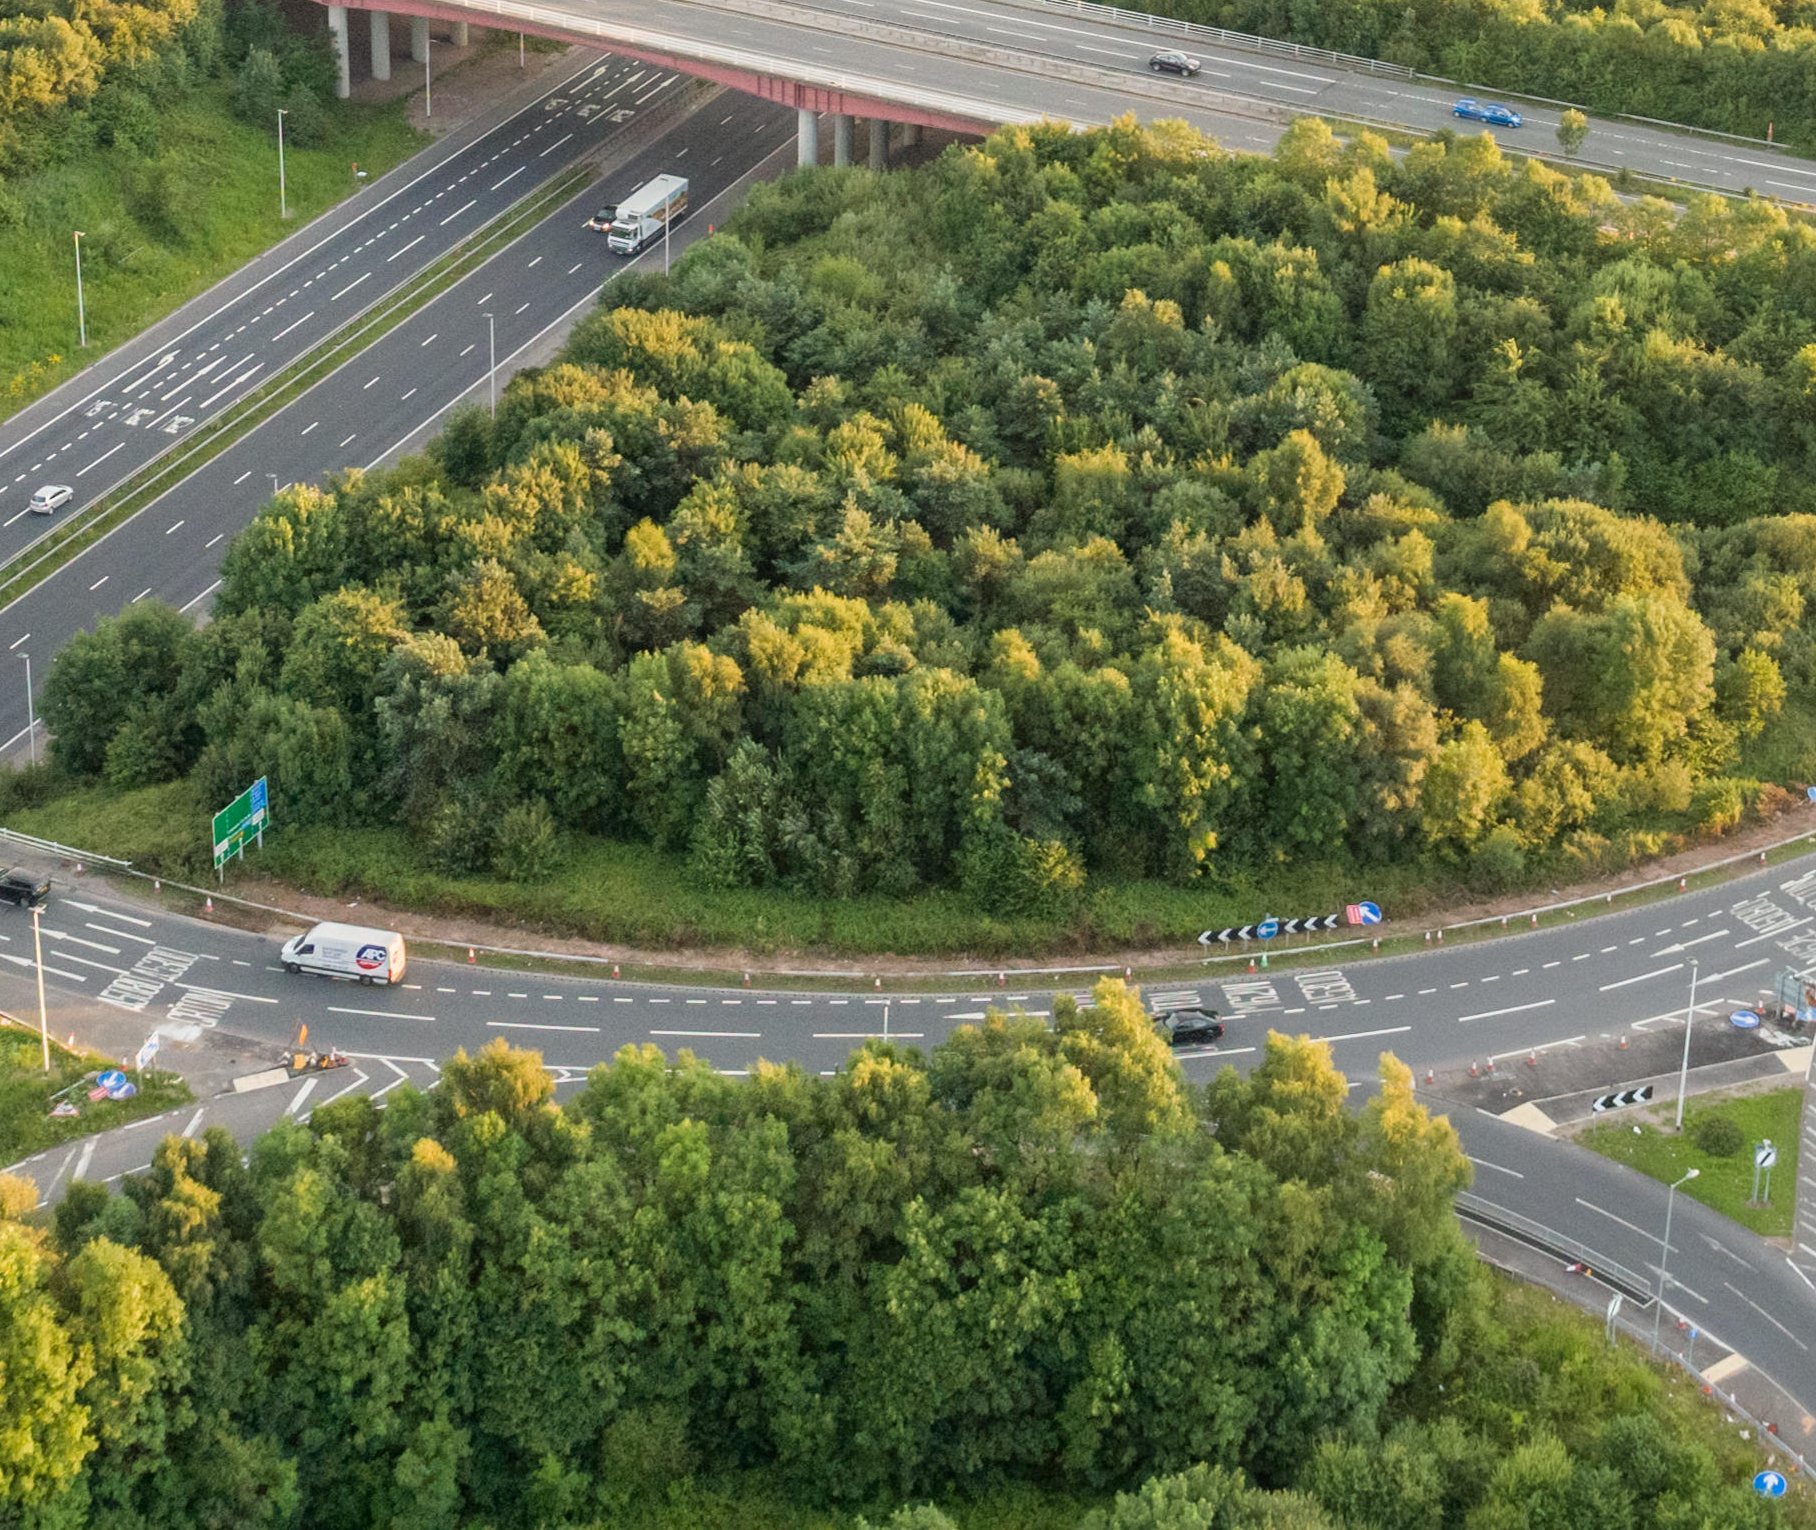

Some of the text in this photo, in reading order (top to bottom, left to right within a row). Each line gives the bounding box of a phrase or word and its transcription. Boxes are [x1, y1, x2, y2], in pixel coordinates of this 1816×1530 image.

[1730, 897, 1800, 934] A5080
[130, 945, 199, 983] A5300
[360, 948, 386, 961] APC
[96, 973, 165, 1013] A5080
[1220, 981, 1285, 1015] M62W
[1294, 970, 1359, 1005] A5300
